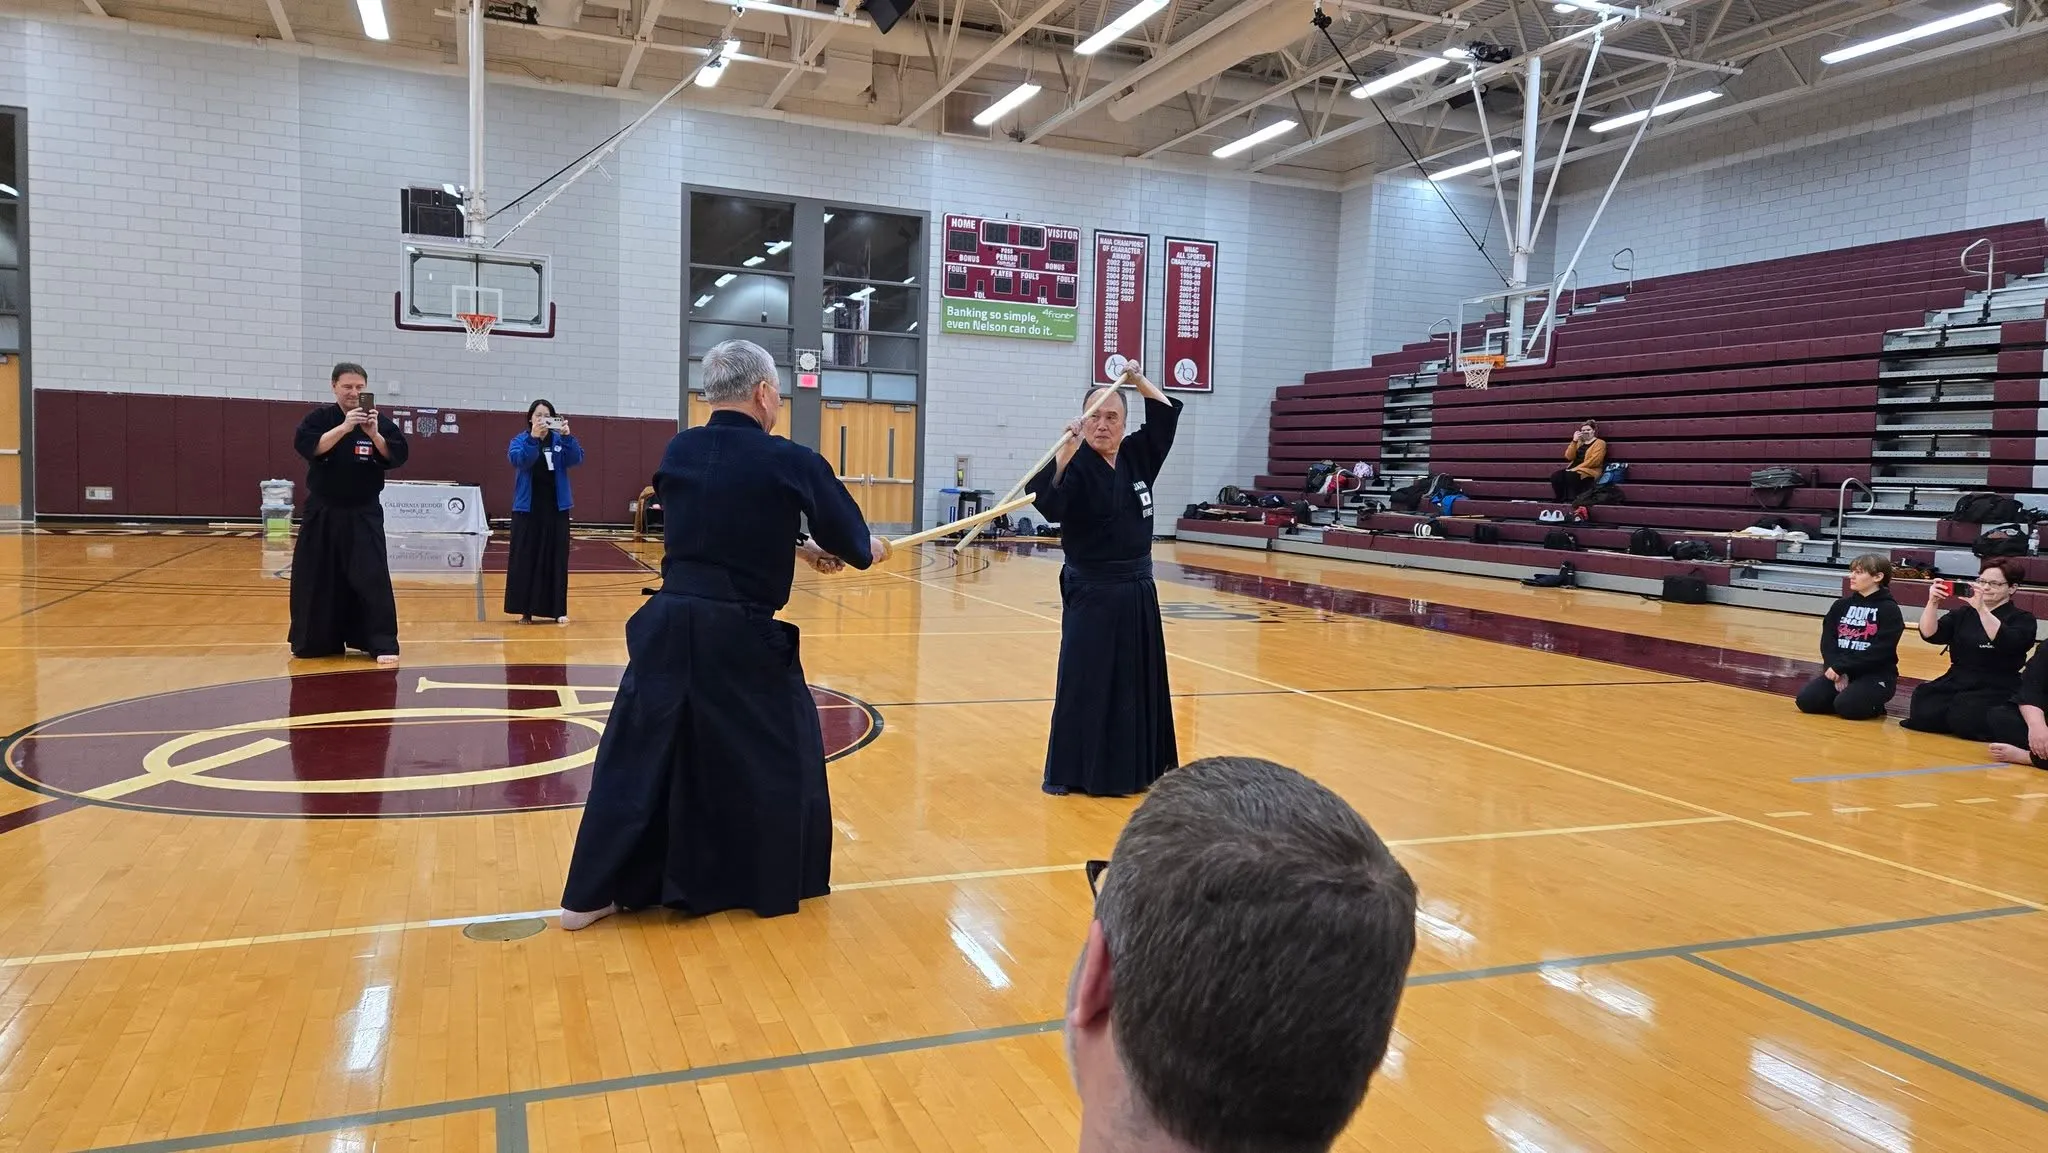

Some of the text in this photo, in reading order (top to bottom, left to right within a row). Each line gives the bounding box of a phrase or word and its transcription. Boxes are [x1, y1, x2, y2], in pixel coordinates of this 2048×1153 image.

[951, 217, 976, 230] HOME
[1047, 228, 1078, 240] VISITOR
[959, 254, 980, 263] BONUS
[995, 253, 1018, 262] PERIOD
[1176, 251, 1206, 261] ALL SPORTS
[947, 265, 967, 274] FOULS
[1045, 262, 1065, 271] BONUS
[991, 270, 1013, 278] PLAYER
[1020, 272, 1039, 281] FOULS
[1057, 276, 1075, 284] FOULS
[974, 291, 986, 299] TOL
[947, 305, 1039, 324] Banking so simple,
[946, 319, 1053, 336] even Nelson can do it.
